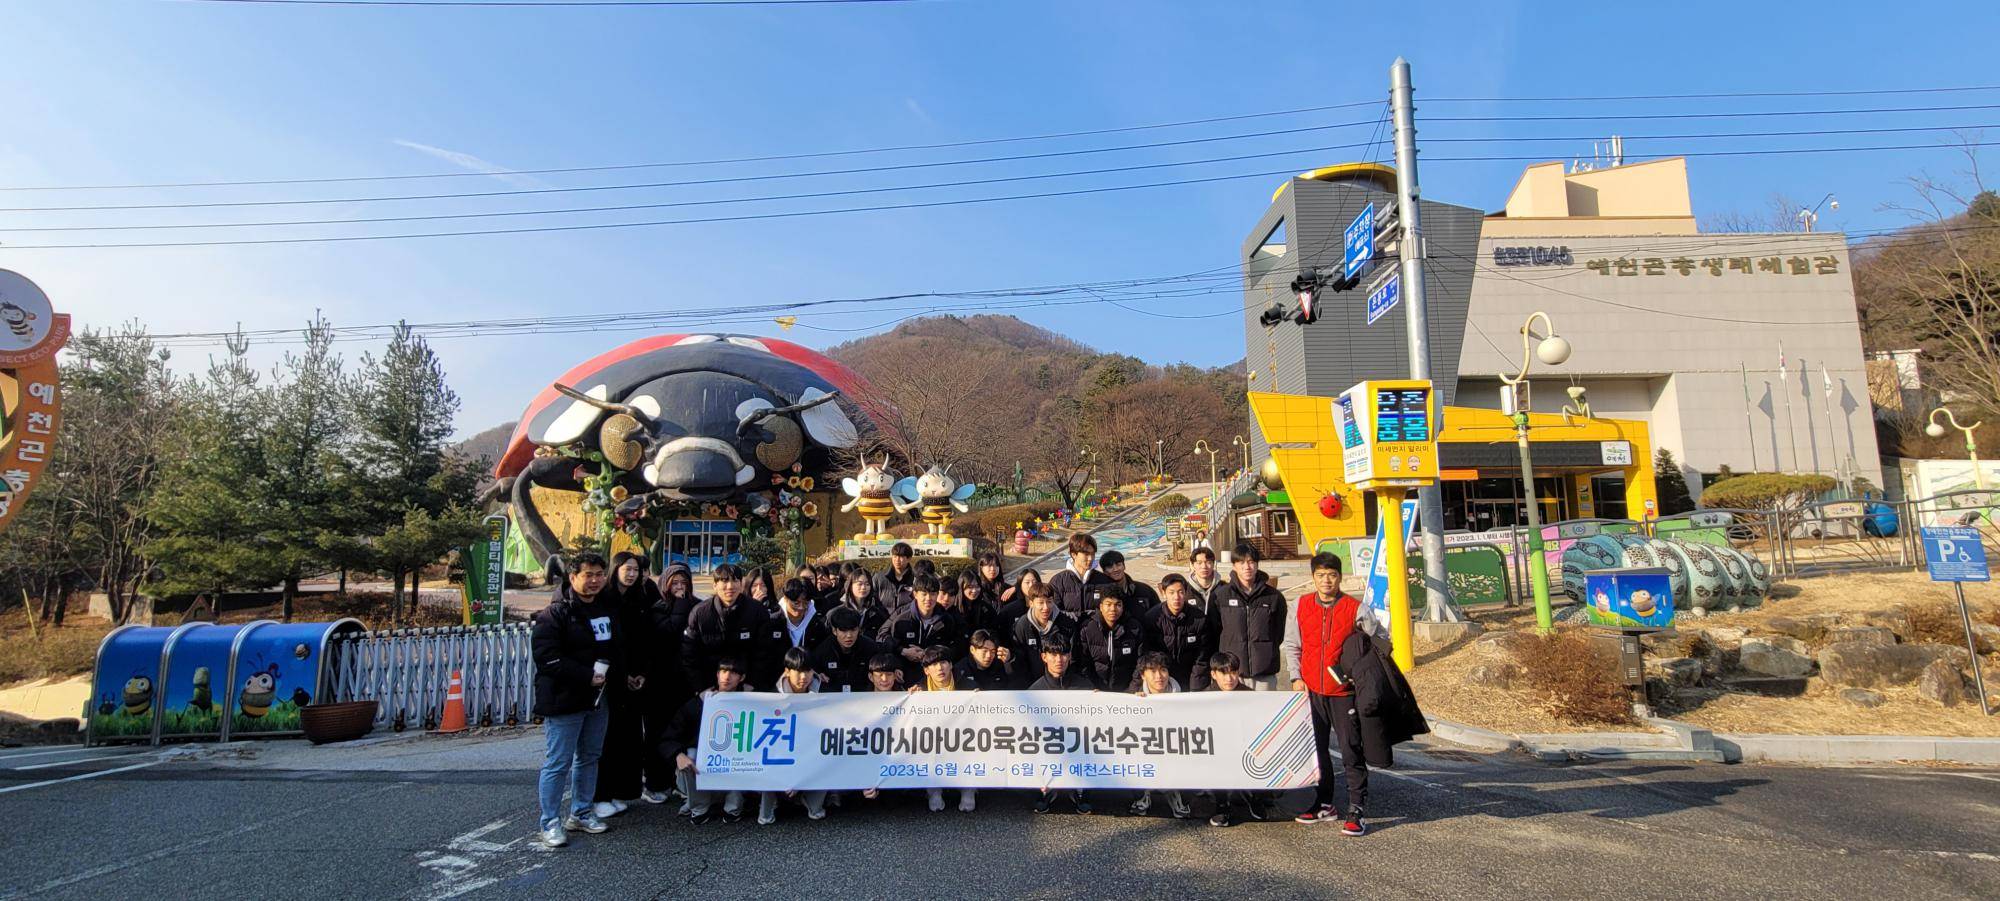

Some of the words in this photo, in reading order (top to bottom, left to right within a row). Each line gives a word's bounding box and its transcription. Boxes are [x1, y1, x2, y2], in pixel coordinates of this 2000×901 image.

[1586, 255, 1840, 276] 예천곤충생태체험관
[1377, 445, 1406, 453] 미세먼지
[1937, 539, 1955, 562] P
[882, 705, 906, 715] 20th
[909, 705, 939, 715] Asian
[943, 705, 965, 715] U20
[968, 705, 1015, 715] Athletics
[1018, 704, 1103, 717] Championships
[1106, 705, 1153, 715] Yecheon
[708, 709, 796, 765] 예천
[820, 727, 1214, 755] 예천아시아U20육상경기선수권대회
[707, 754, 730, 767] 20th
[879, 764, 928, 777] 2023년
[935, 763, 958, 777] 6월
[963, 763, 986, 777] 4일
[1011, 763, 1034, 776] 6월
[1040, 763, 1063, 776] 7일
[1069, 763, 1156, 777] 예천스타디움
